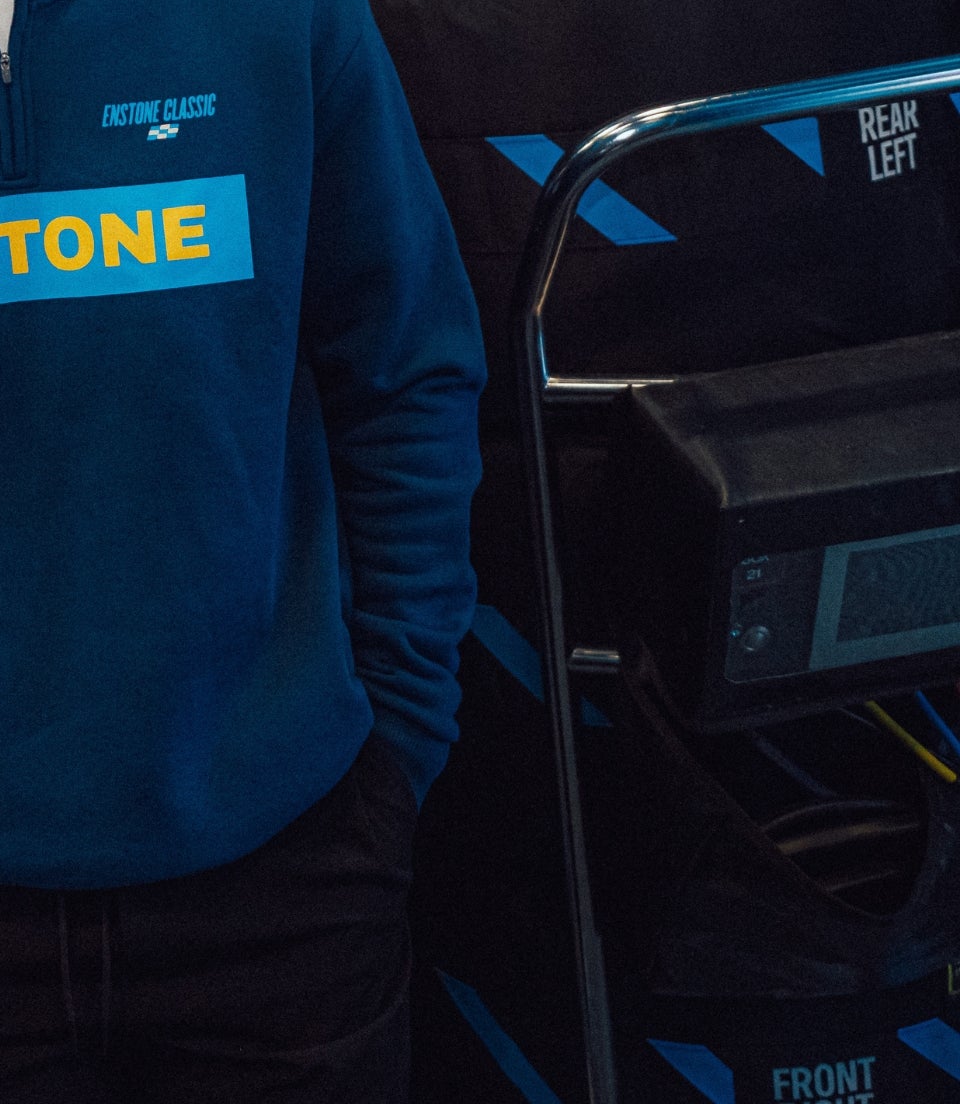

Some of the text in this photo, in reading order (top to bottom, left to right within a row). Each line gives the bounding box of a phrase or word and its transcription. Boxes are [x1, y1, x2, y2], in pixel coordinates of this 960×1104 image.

[101, 92, 217, 128] ENSTONE CLASSIC
[858, 99, 920, 145] REAR
[867, 132, 918, 182] LEFT
[771, 1055, 878, 1102] FRONT
